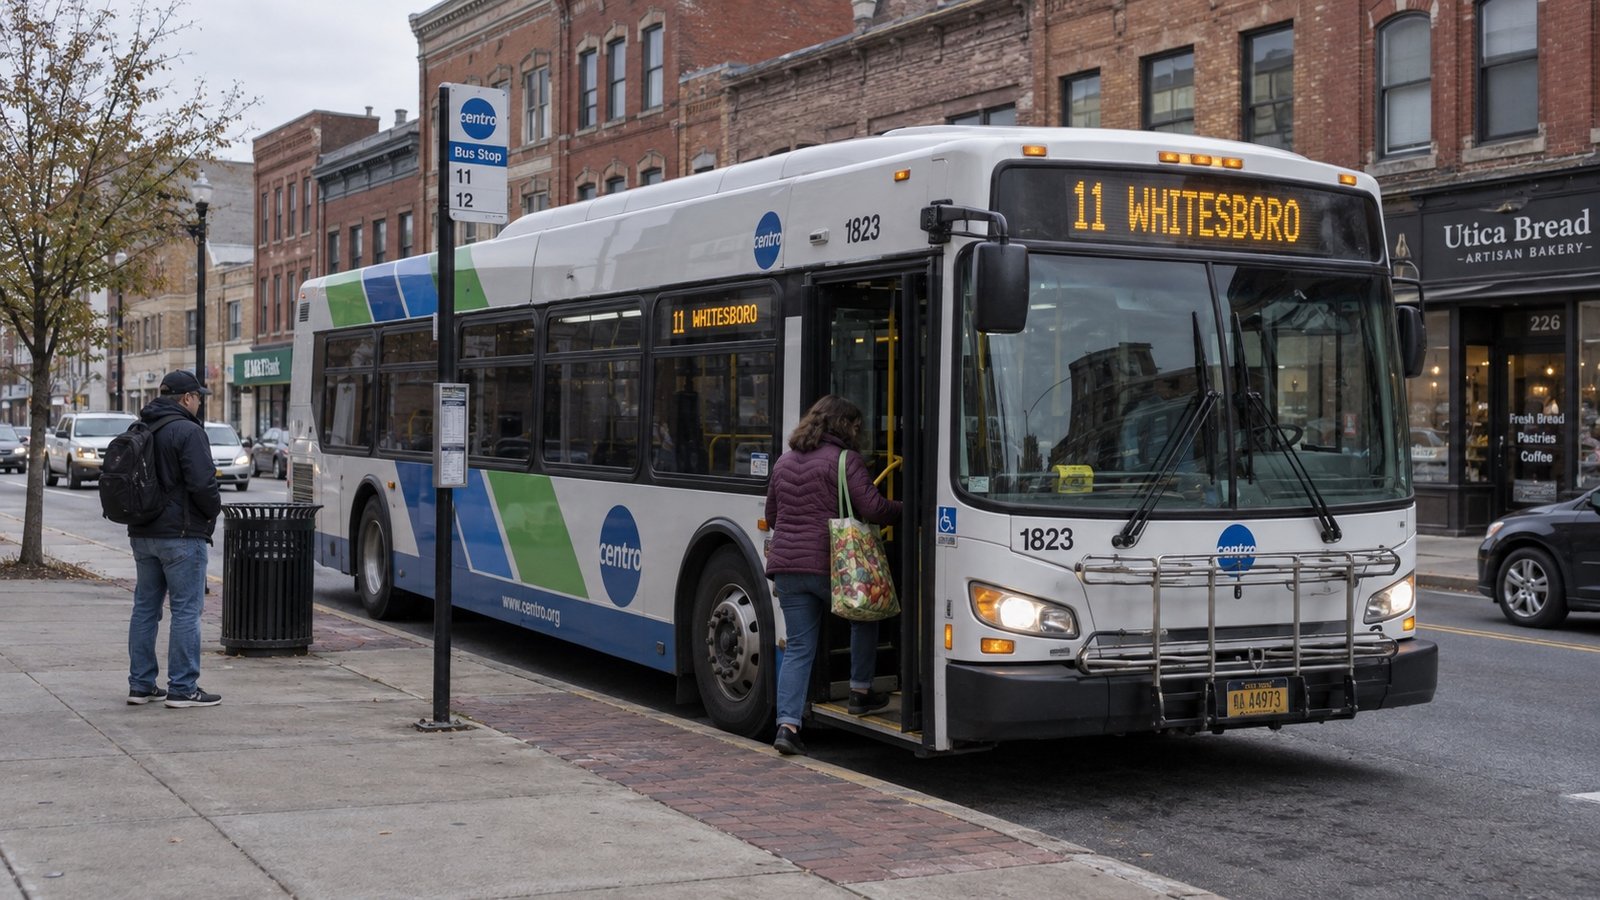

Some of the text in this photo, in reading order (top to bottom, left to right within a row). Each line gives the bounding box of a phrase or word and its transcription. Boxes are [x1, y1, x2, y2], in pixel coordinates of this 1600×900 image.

[460, 112, 497, 126] centro
[454, 146, 502, 164] Bus Stop
[456, 168, 471, 184] 11
[456, 192, 473, 208] 12
[1074, 180, 1300, 242] 11 WHITESBORO
[845, 214, 880, 244] 1823
[1443, 208, 1592, 249] Utica Bread
[754, 230, 782, 250] centro
[672, 303, 758, 335] 11 WHITESBORO
[1530, 314, 1561, 332] 226
[1509, 412, 1535, 424] Fresh
[1517, 431, 1557, 444] Pastries
[1520, 450, 1553, 463] Coffee
[1020, 527, 1074, 551] 1823
[600, 541, 642, 572] centro
[502, 595, 561, 628] www.centro.org
